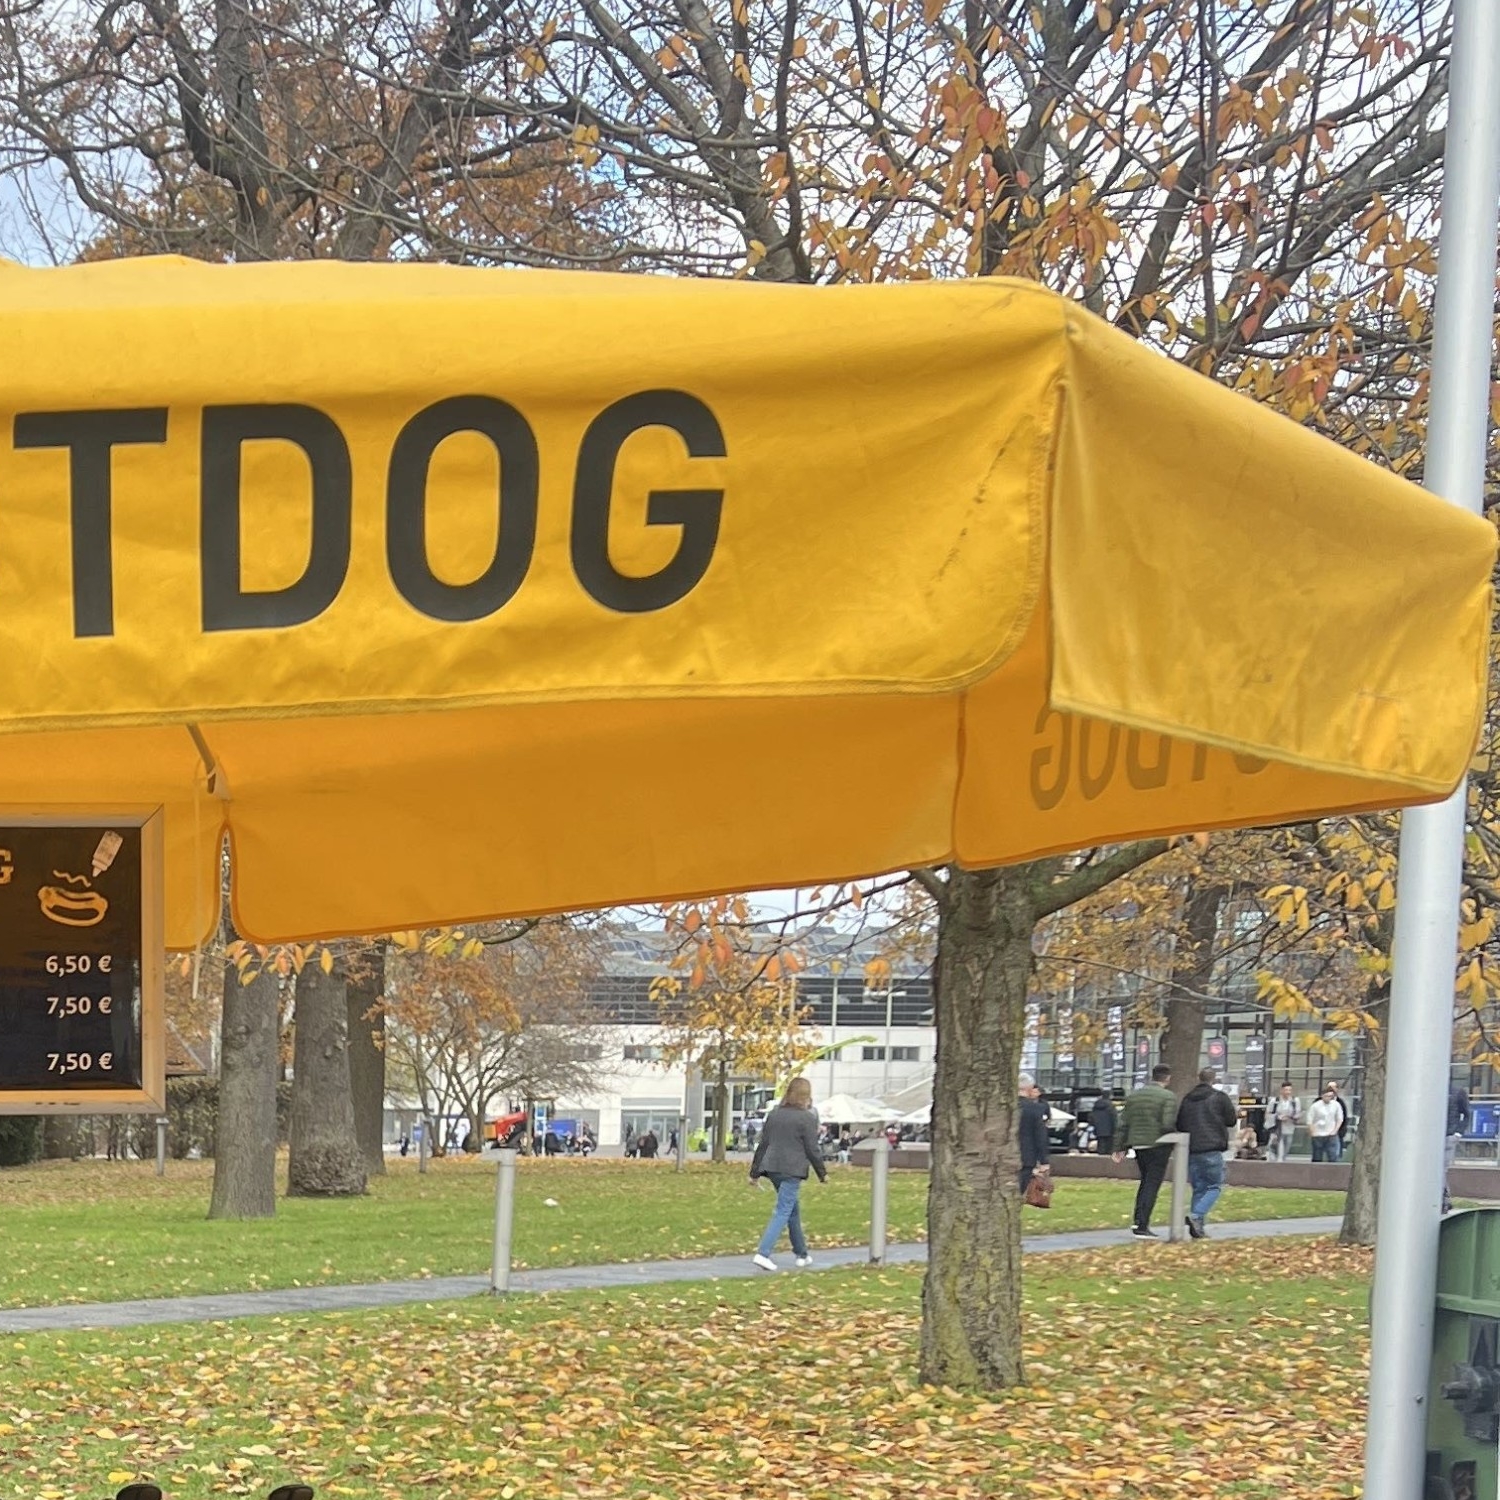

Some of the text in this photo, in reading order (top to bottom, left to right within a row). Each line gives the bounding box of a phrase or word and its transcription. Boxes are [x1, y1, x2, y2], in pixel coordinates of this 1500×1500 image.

[45, 955, 91, 976] 6,50
[98, 955, 112, 973] €
[46, 996, 91, 1017] 7,50
[99, 997, 112, 1014] €
[46, 1053, 92, 1073] 7,50
[99, 1053, 112, 1070] €
